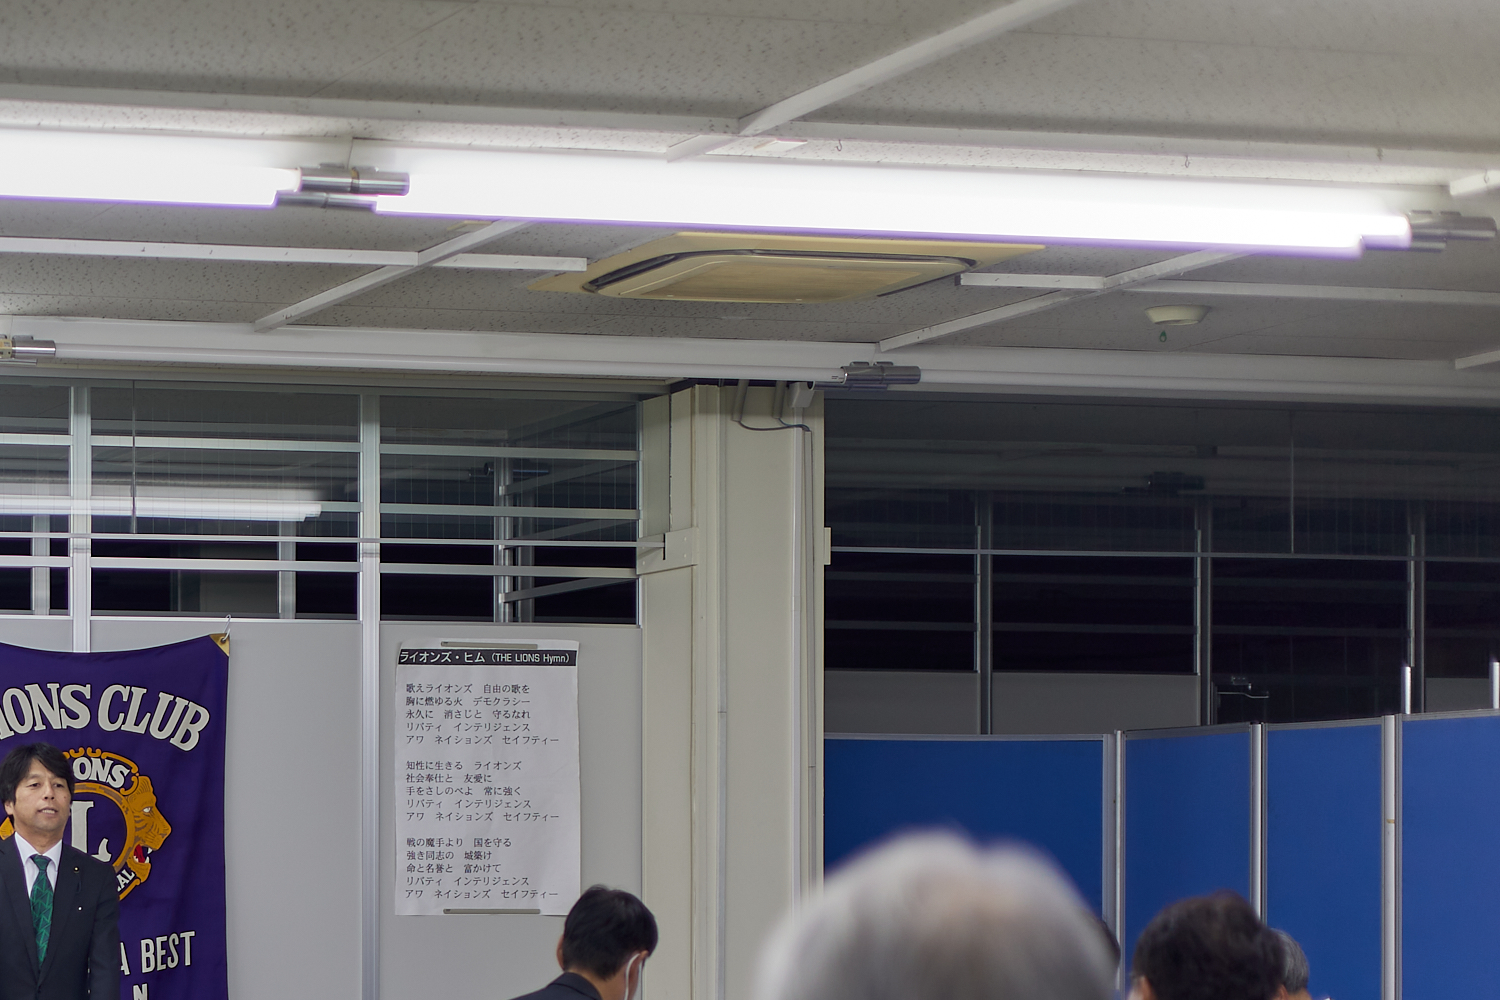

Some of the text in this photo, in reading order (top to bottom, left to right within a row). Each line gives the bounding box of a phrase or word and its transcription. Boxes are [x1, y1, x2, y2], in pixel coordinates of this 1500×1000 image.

[400, 651, 486, 664] ライオンズ・ヒム
[515, 653, 540, 664] LIONS
[405, 682, 530, 695] 歌えライオンズ 自由の歌を
[472, 695, 531, 707] デモクラシー
[97, 684, 210, 752] CLUB
[405, 708, 434, 720] 永久に
[492, 708, 531, 720] 守るなれ
[453, 722, 531, 733] インテリジェンス
[406, 734, 560, 746] アワ ネイションズ セイフティー
[405, 760, 522, 771] 知性に生きる ライオンズ
[72, 756, 131, 789] ONS
[405, 772, 493, 784] 社会奉仕と 友愛に
[483, 785, 522, 797] 常に強く
[454, 798, 532, 809] インテリジェンス
[406, 811, 560, 822] アワ ネイションズ セイフティー
[473, 837, 512, 848] 国を守る
[406, 849, 455, 861] 強き同志の
[406, 862, 453, 874] 命と名誉と
[453, 876, 530, 887] インテリジェンス
[405, 888, 559, 899] アワ ネイションズ セイフティー
[140, 930, 196, 974] BEST
